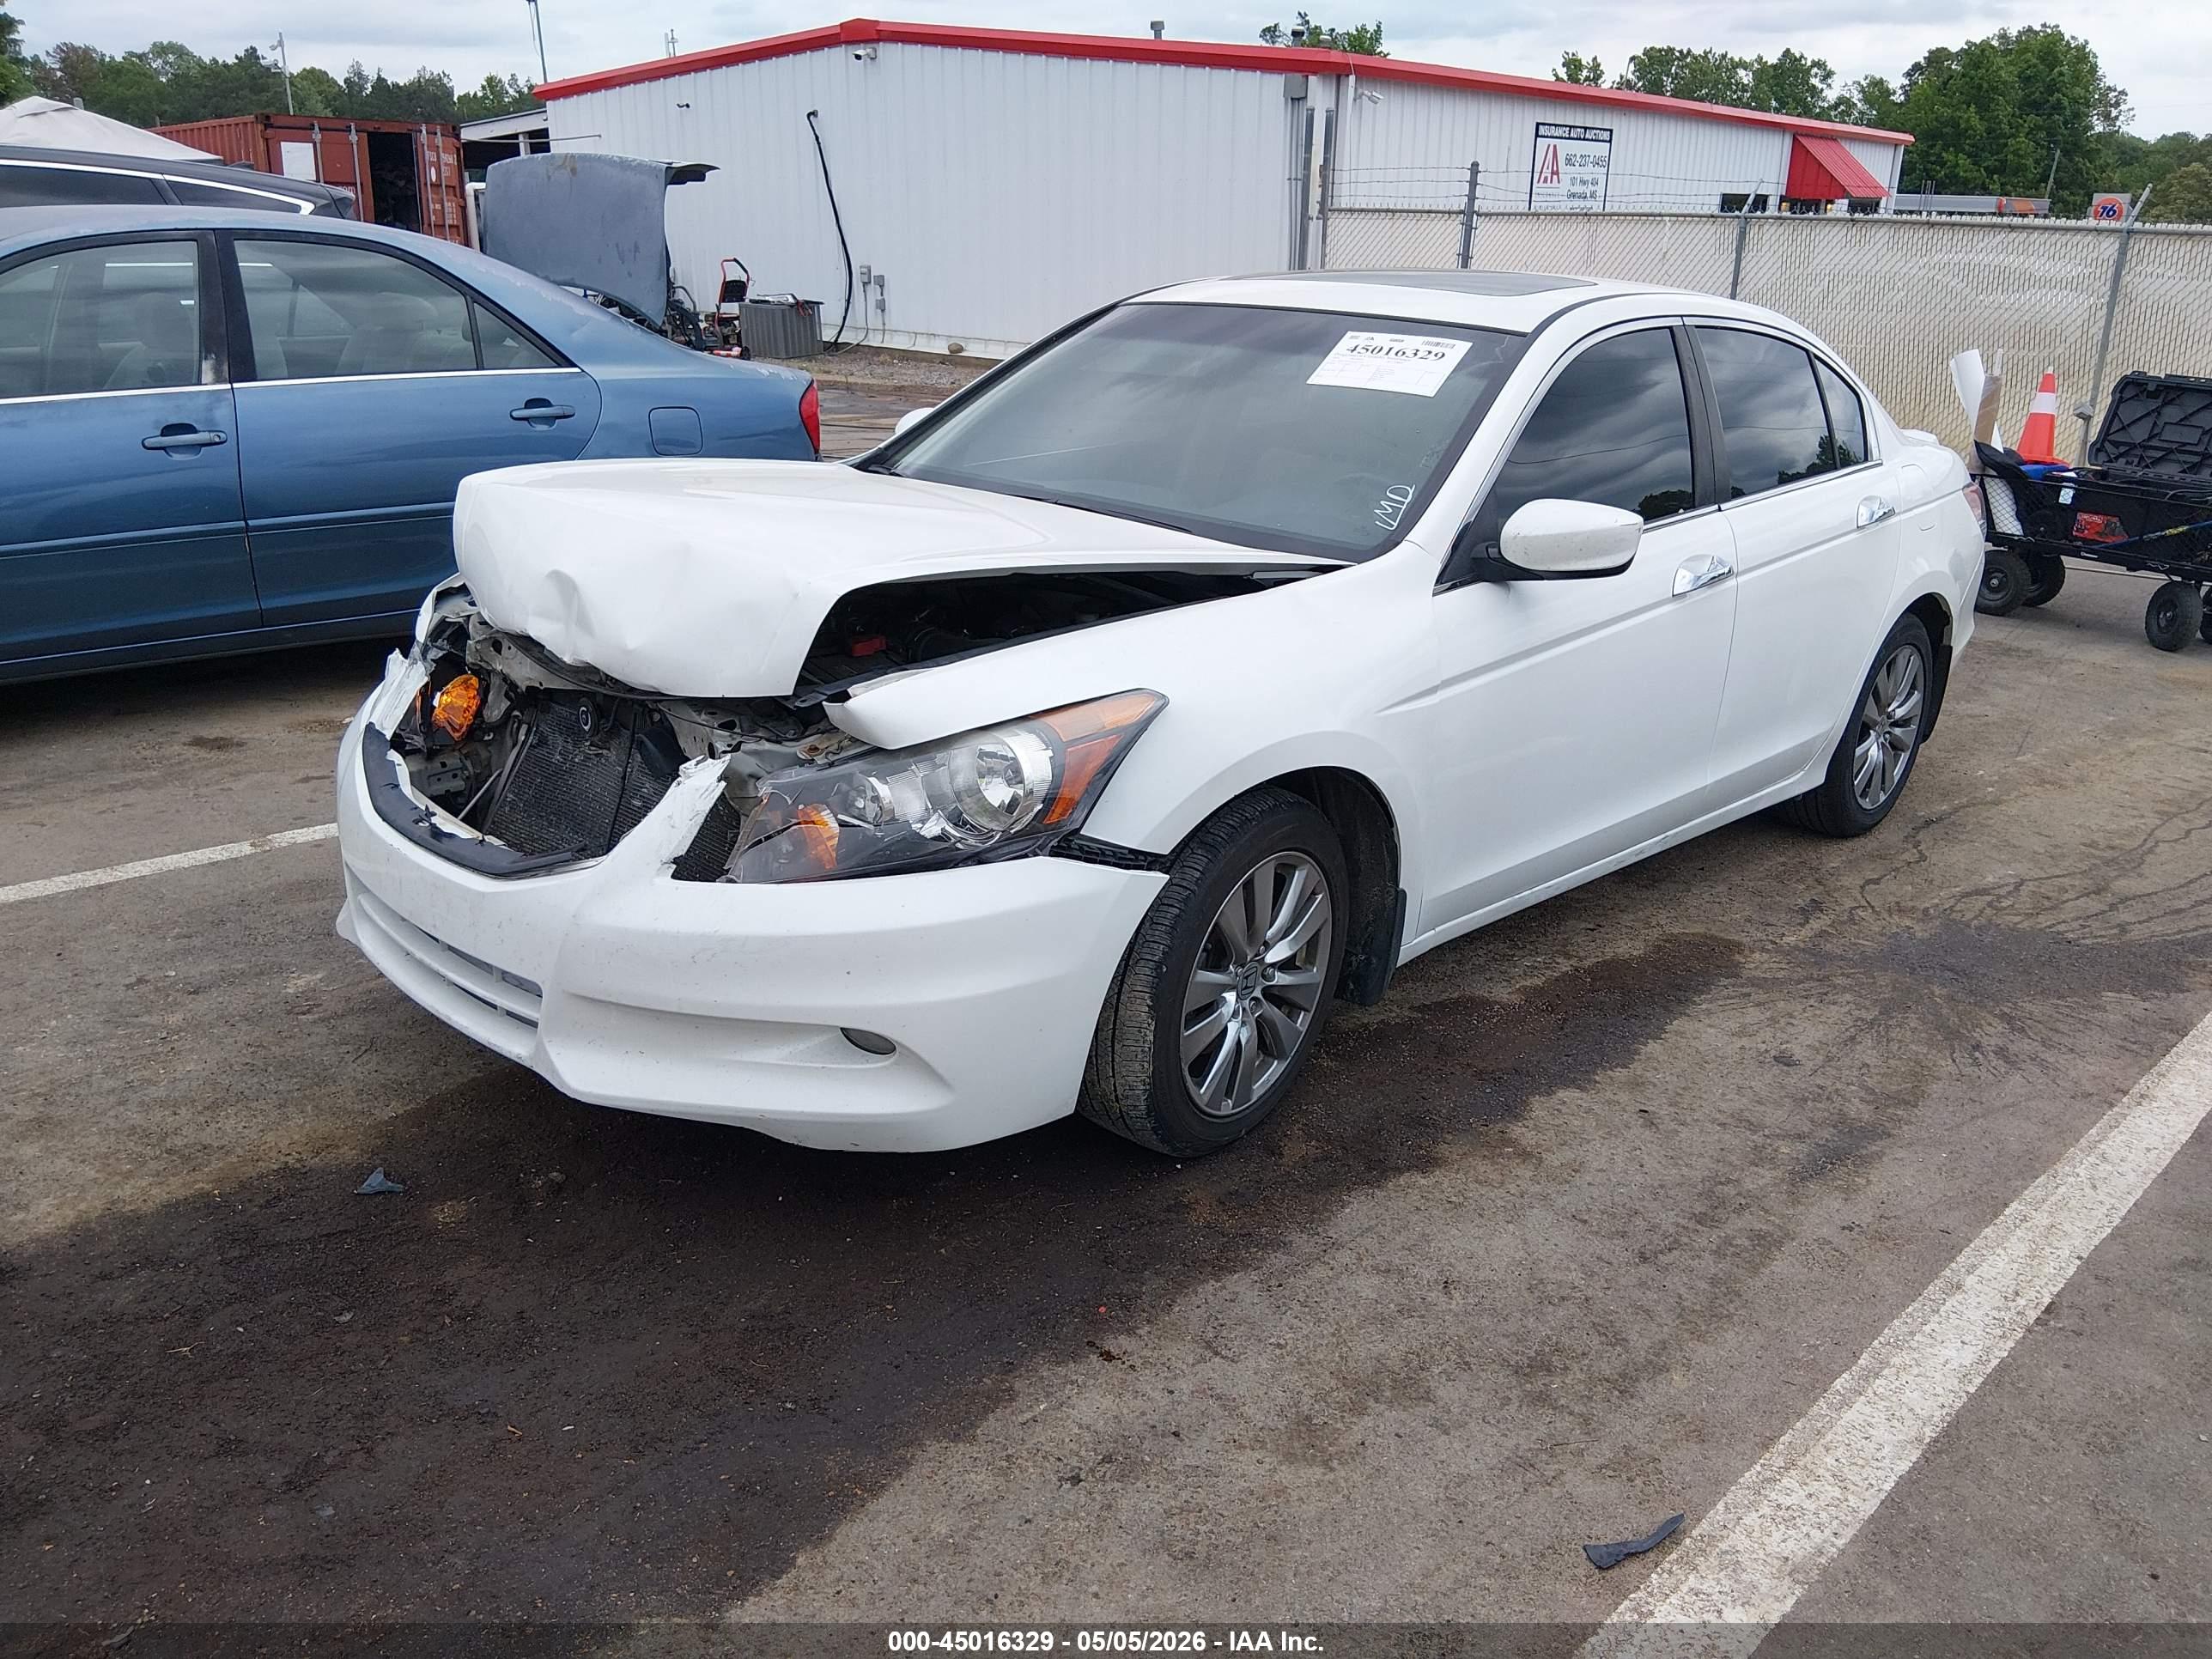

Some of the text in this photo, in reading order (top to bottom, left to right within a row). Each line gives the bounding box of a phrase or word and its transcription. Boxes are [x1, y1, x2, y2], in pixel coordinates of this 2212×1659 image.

[1538, 125, 1611, 141] INSURANCE AUTO AUCTIONS
[1565, 153, 1607, 168] 662-237-0455
[1570, 175, 1599, 188] 101 Hwy 404
[1589, 189, 1598, 200] MS
[2098, 204, 2118, 218] 76
[1346, 343, 1446, 362] 45016329
